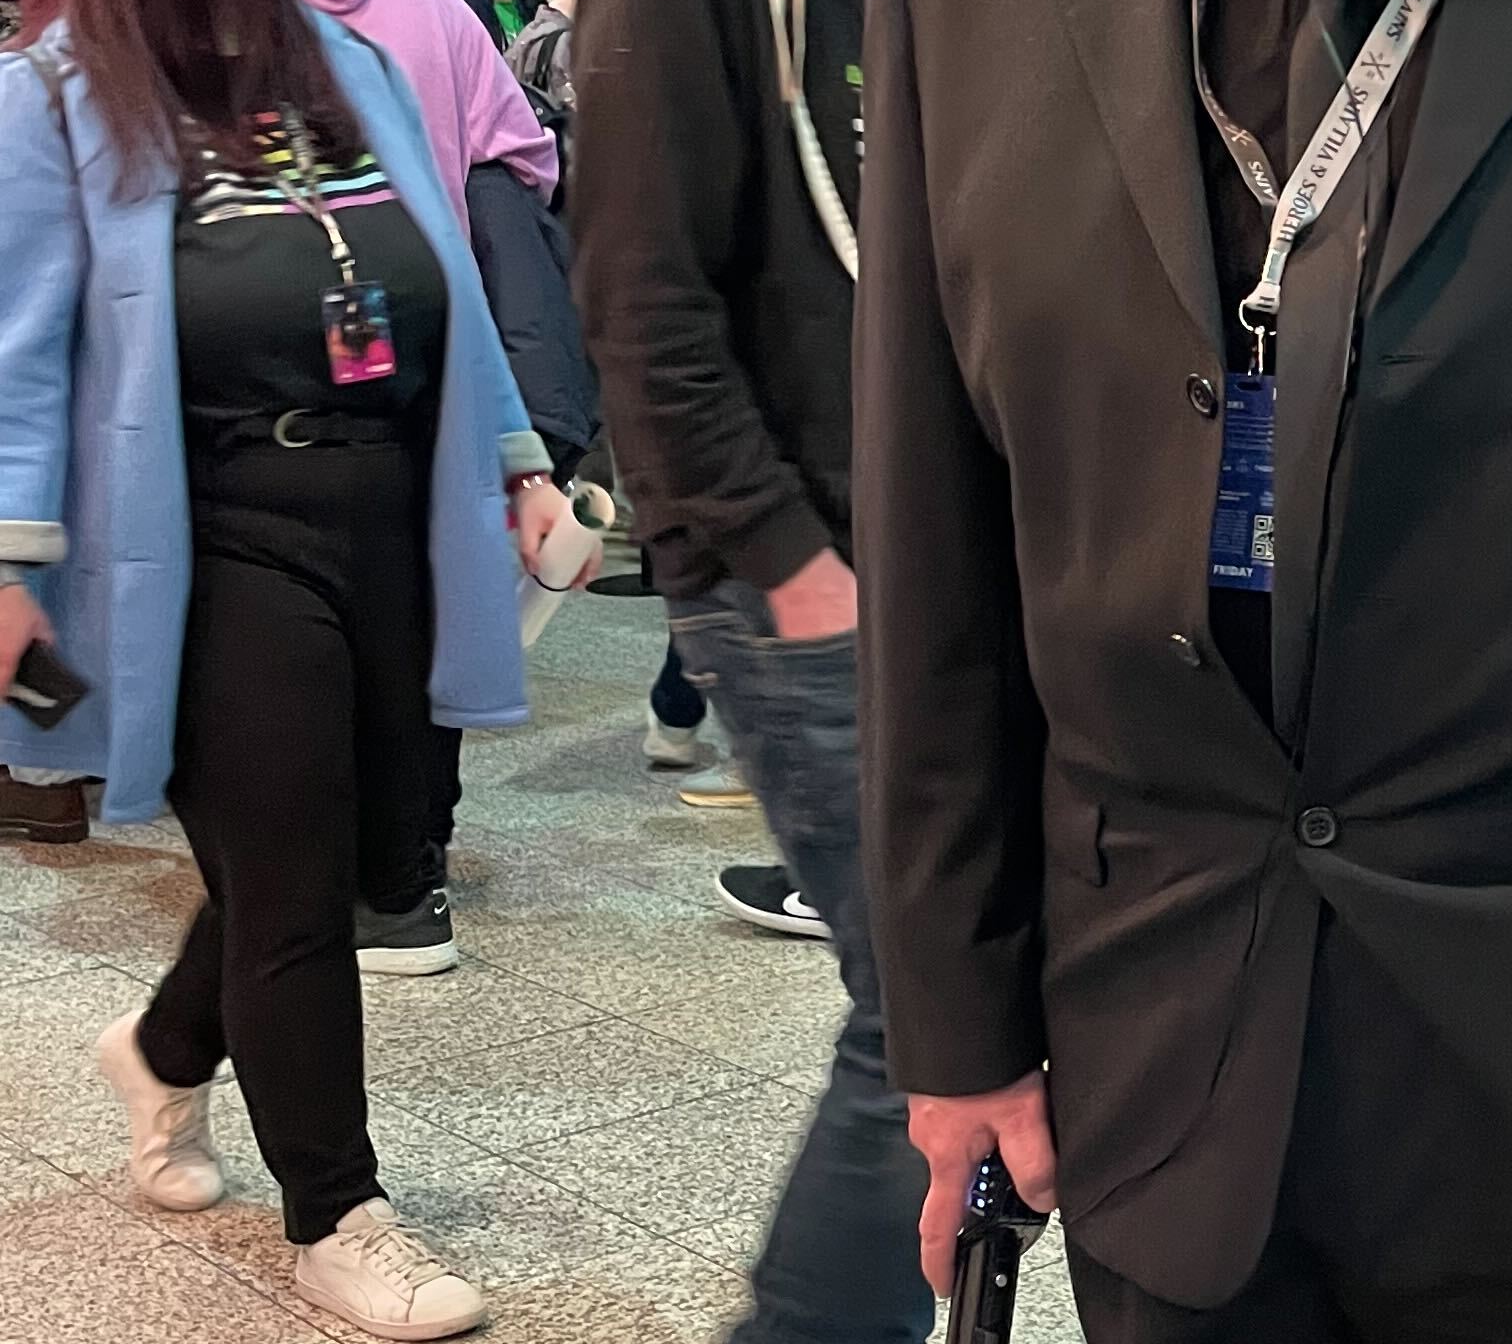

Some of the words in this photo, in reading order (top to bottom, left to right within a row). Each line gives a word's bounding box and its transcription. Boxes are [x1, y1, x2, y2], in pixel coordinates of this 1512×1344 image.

[1317, 86, 1368, 161] VILLAINS
[1311, 164, 1327, 178] &
[1277, 179, 1317, 243] HEROES
